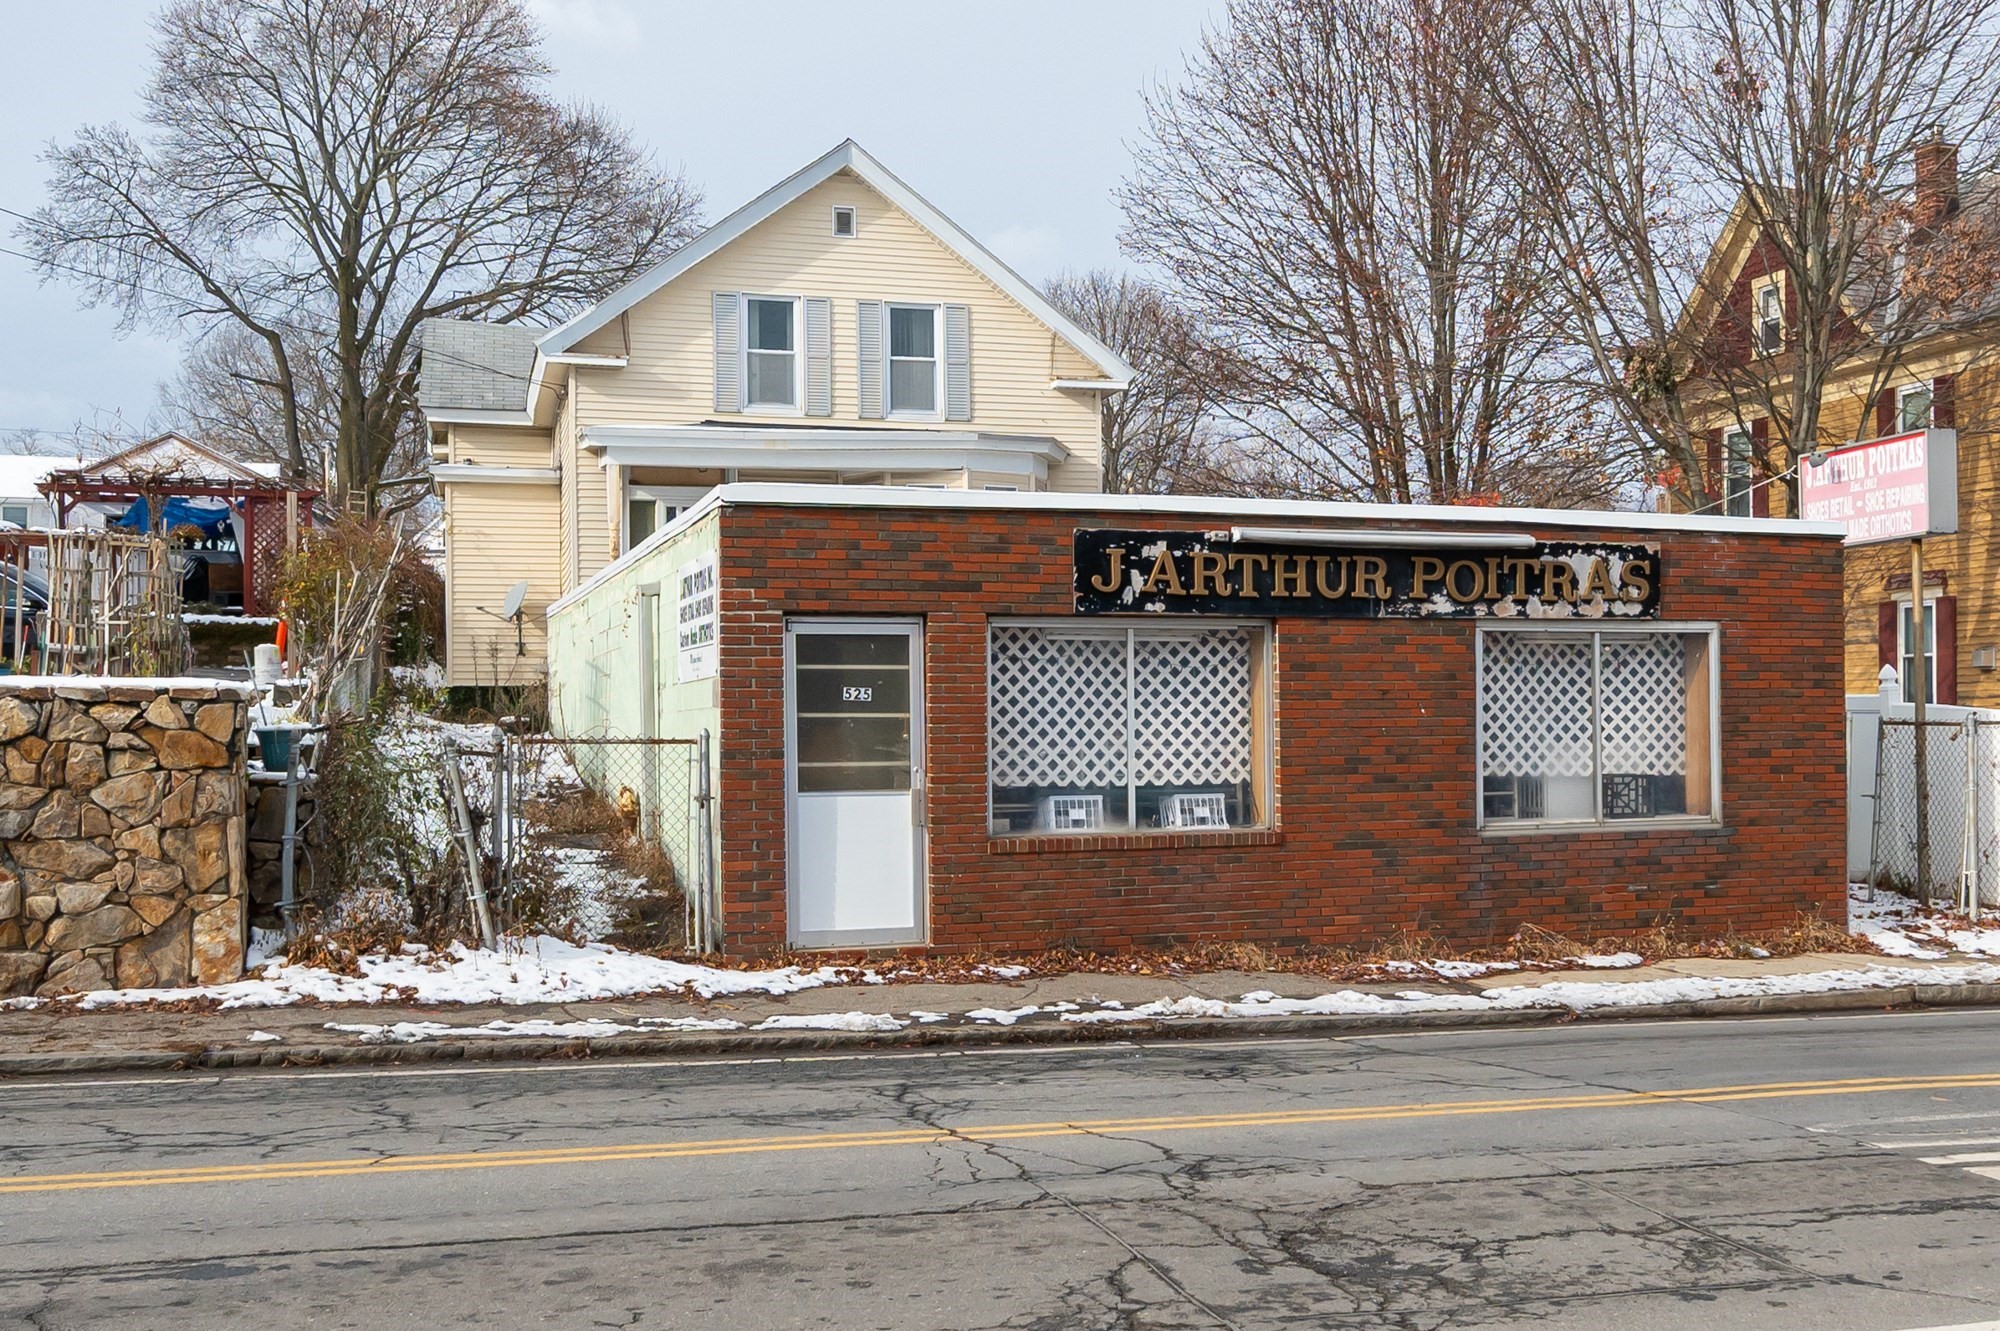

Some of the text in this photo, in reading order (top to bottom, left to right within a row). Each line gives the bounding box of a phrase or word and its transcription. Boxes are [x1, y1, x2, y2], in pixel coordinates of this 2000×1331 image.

[1868, 437, 1924, 477] POITRAS
[1806, 483, 1925, 521] SHOES RETAIL SHOE REPAIRING
[1848, 516, 1869, 539] MADE
[1870, 510, 1912, 536] ORTHOTICS
[1141, 549, 1392, 600] ARTHUR
[1409, 556, 1651, 603] POITRAS
[844, 687, 871, 700] 525
